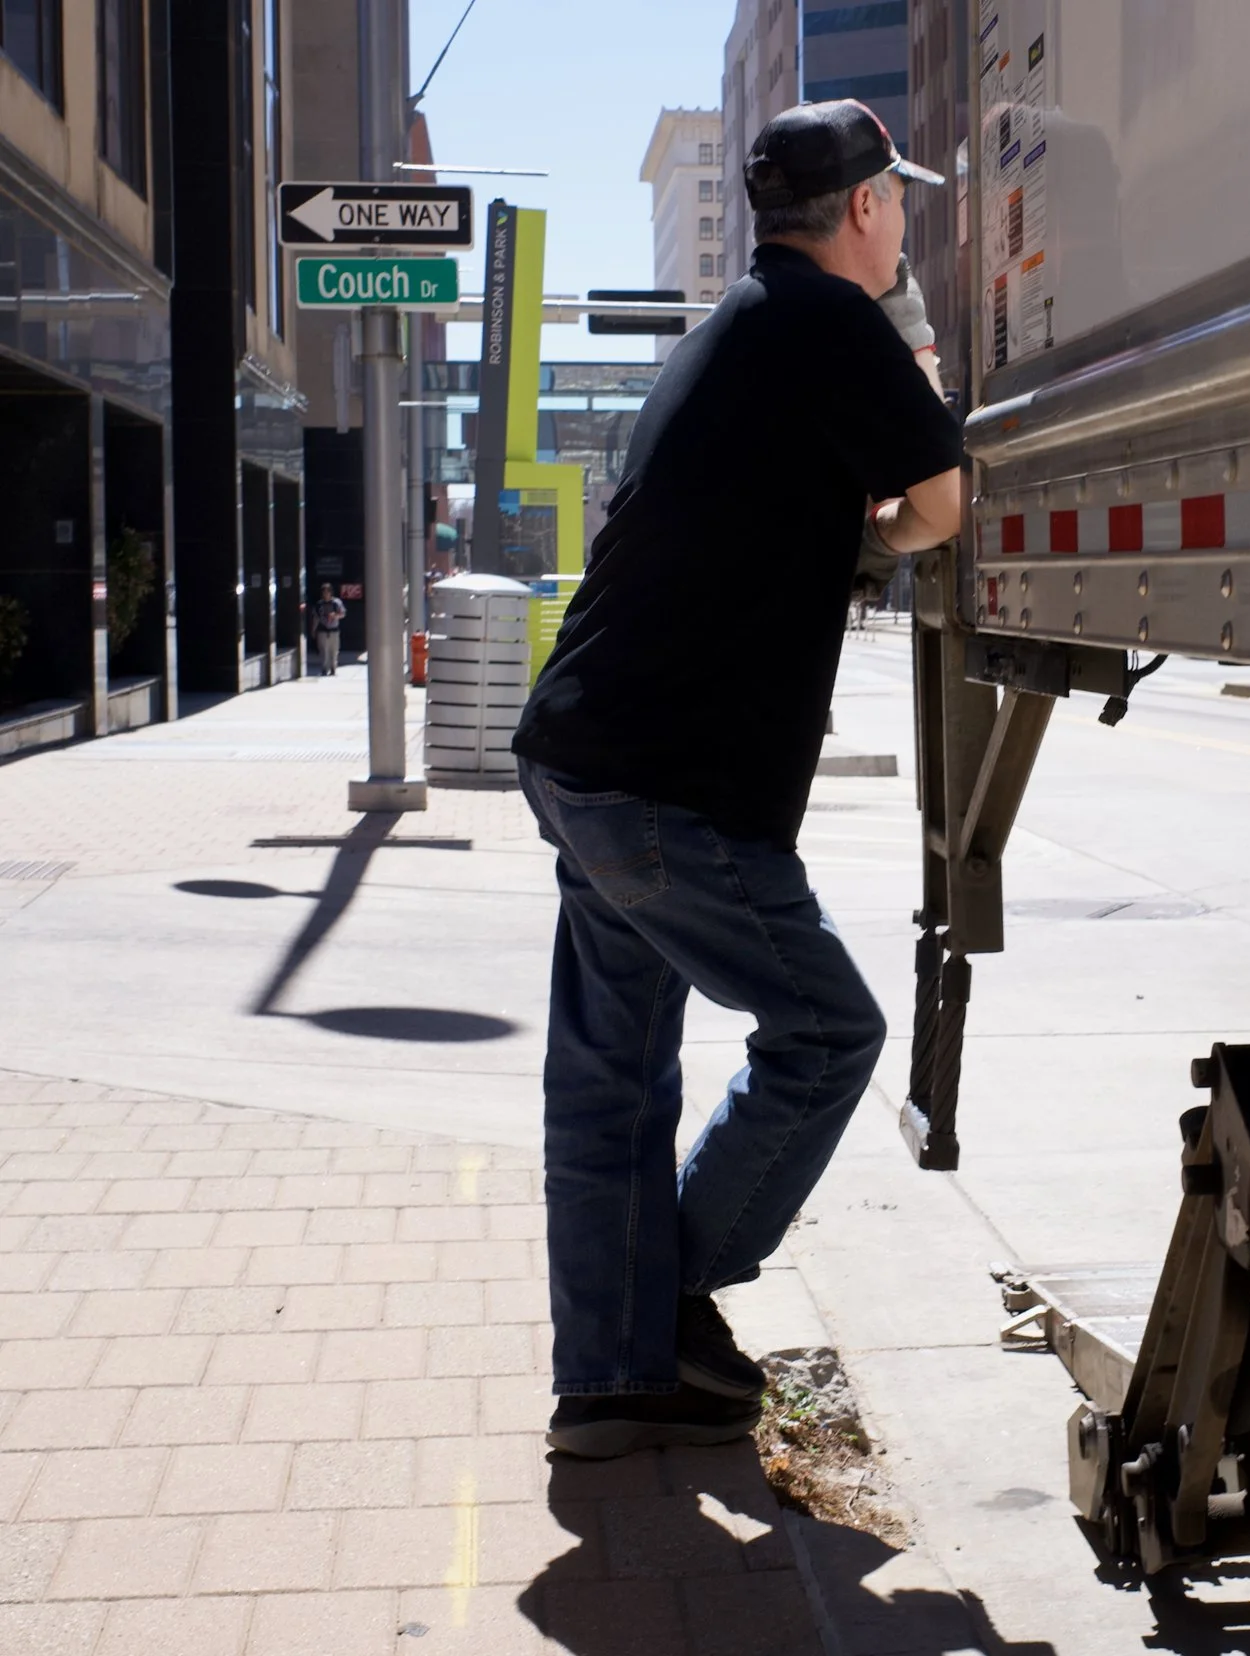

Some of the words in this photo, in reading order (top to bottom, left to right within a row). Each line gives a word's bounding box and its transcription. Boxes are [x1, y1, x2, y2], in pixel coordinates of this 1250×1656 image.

[338, 203, 389, 226] ONE
[399, 204, 450, 227] WAY
[494, 228, 507, 269] PARK
[317, 263, 410, 299] Couch
[420, 280, 438, 298] Dr
[493, 272, 505, 283] &
[489, 286, 505, 365] ROBINSON
